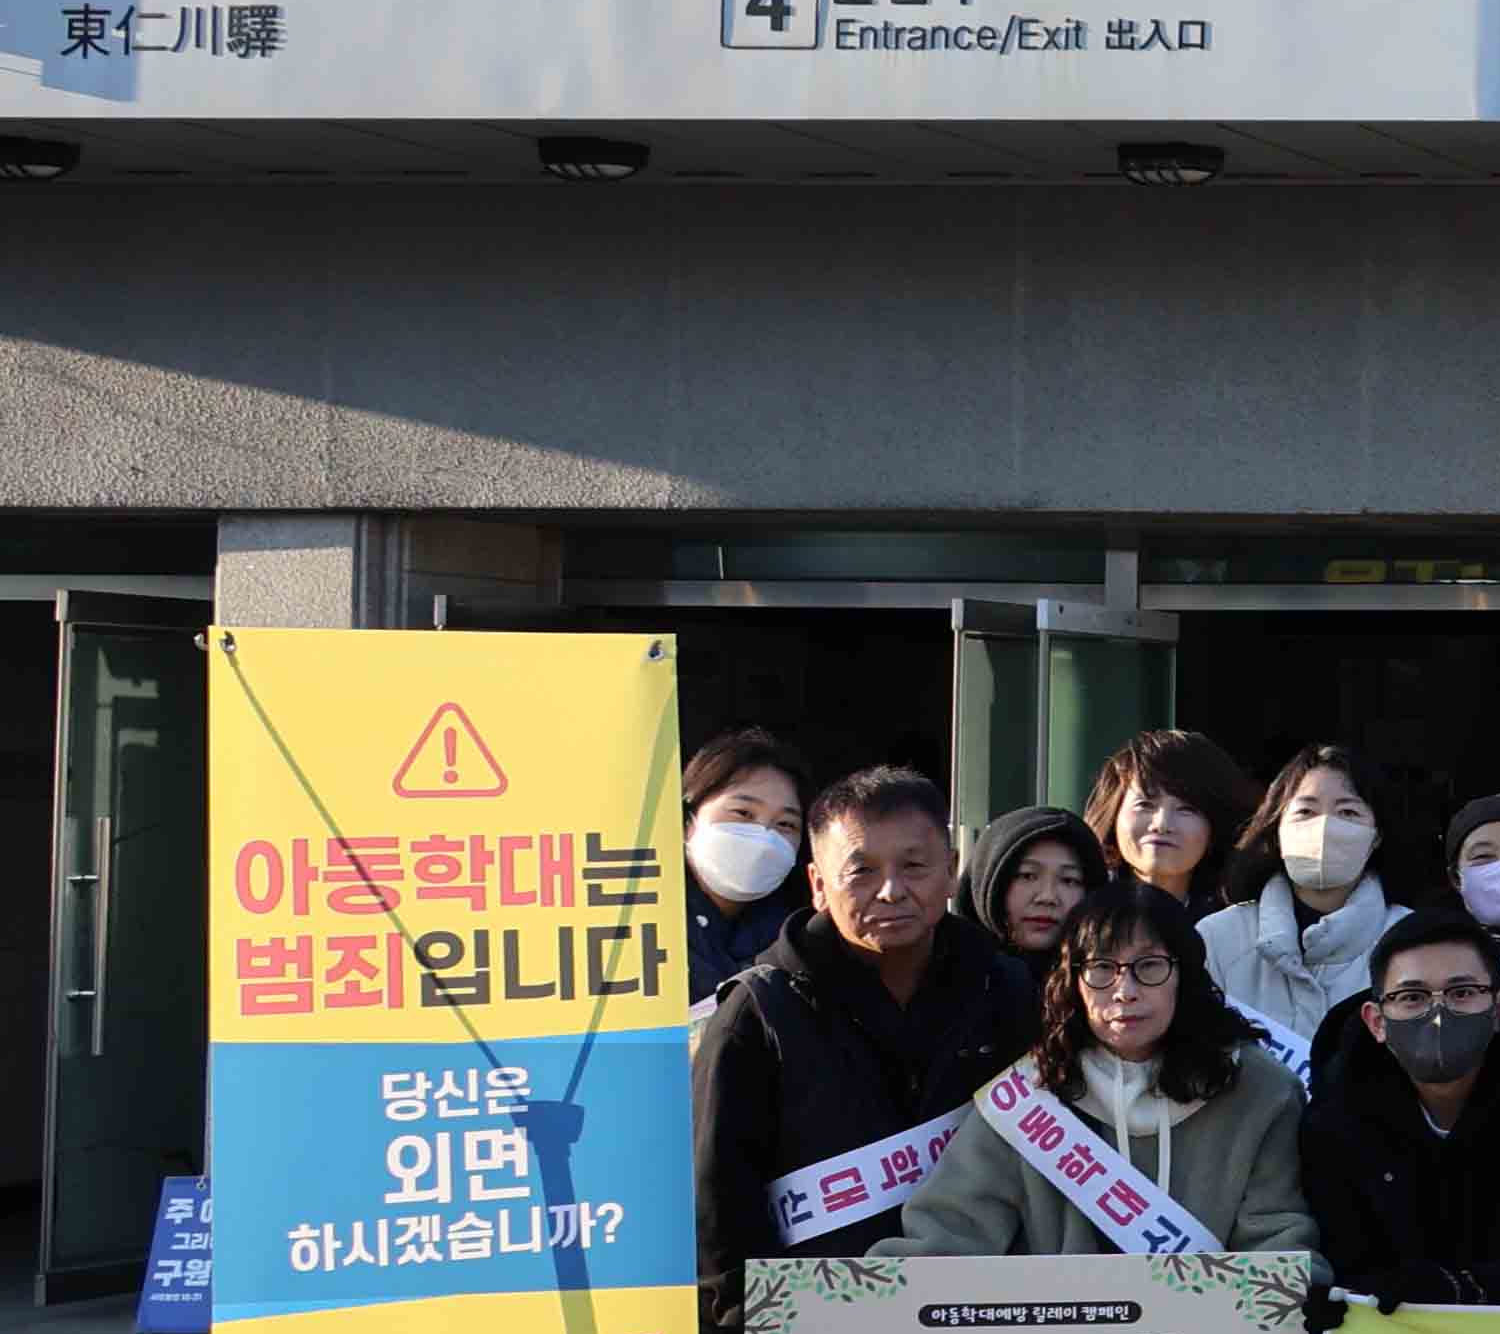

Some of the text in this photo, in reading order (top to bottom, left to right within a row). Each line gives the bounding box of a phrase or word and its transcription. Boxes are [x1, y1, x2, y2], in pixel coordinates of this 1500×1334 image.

[60, 3, 286, 60] 東仁川驛
[835, 15, 1083, 55] Entrance/Exit
[1104, 18, 1211, 52] 出入口
[235, 831, 662, 918] 아동학대는
[235, 922, 669, 1018] 범죄입니다
[380, 1064, 531, 1123] 당신은
[384, 1127, 532, 1205] 외면
[989, 1069, 1150, 1227] 아동학대
[287, 1200, 624, 1276] 하시겠습니까?
[931, 1304, 1130, 1325] 아동학대예방 릴레이 캠페인
